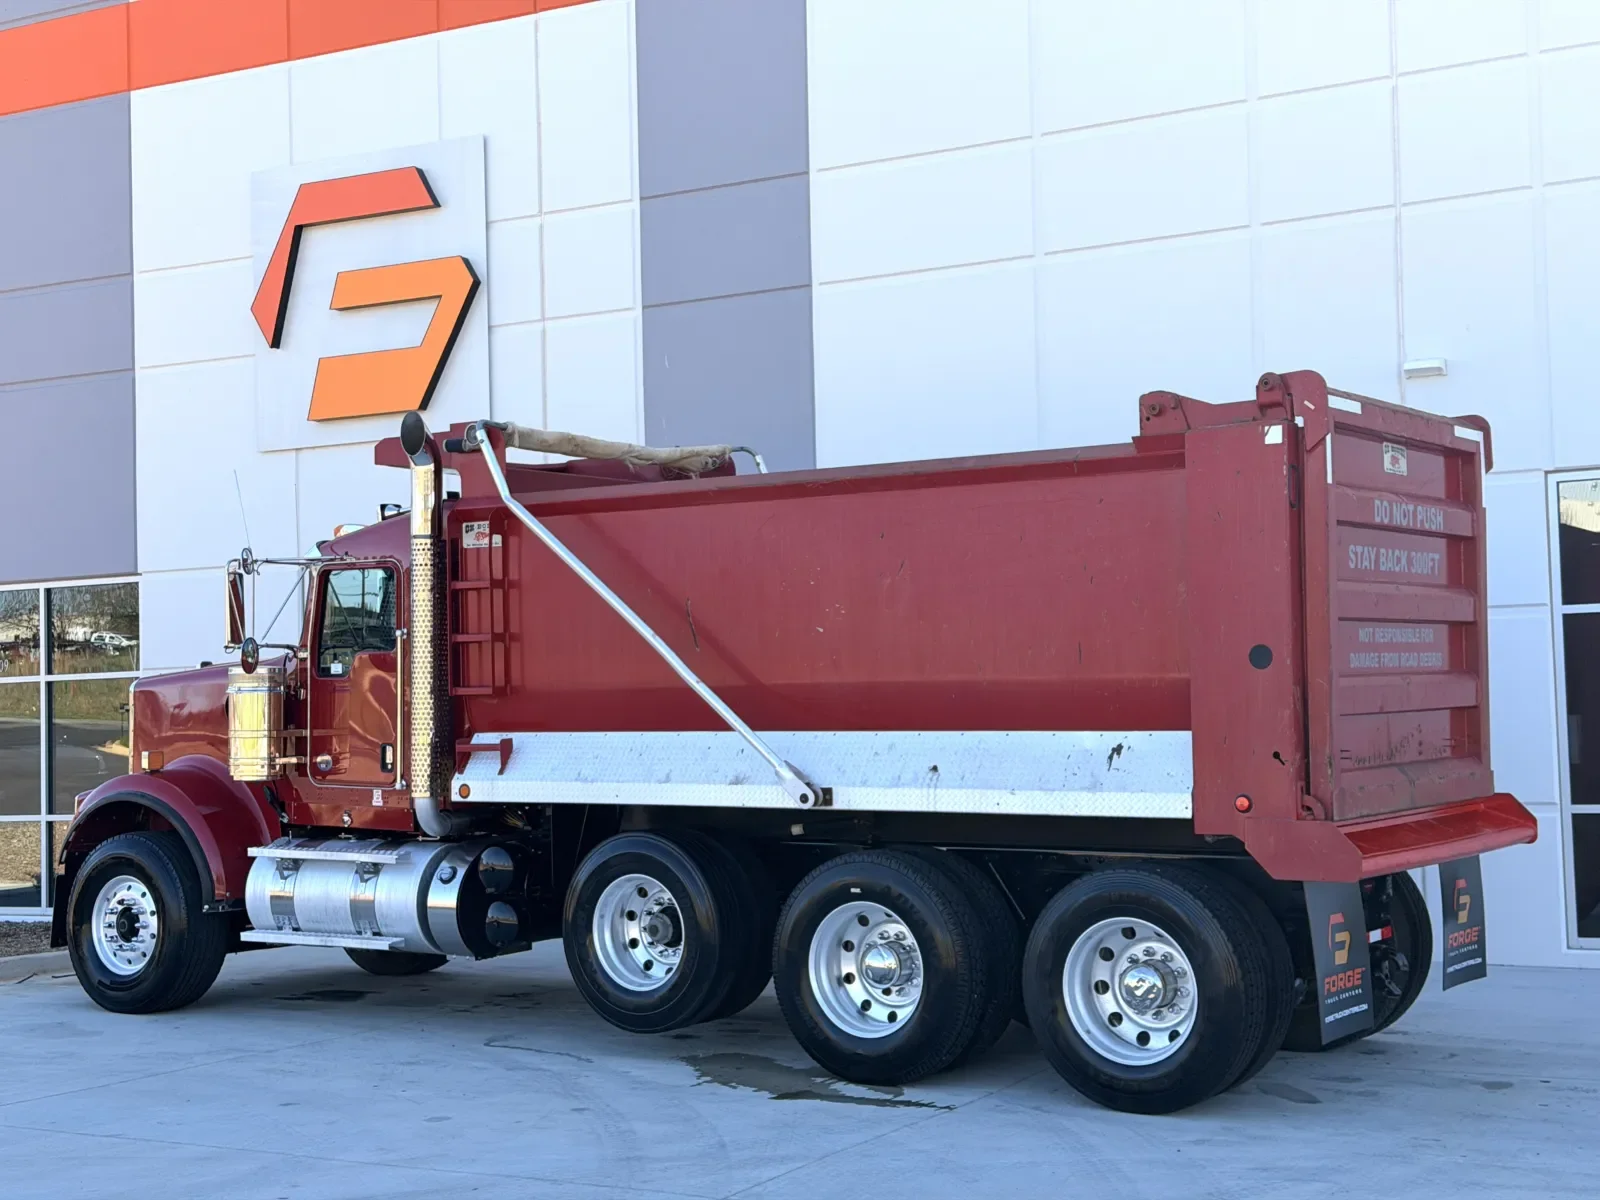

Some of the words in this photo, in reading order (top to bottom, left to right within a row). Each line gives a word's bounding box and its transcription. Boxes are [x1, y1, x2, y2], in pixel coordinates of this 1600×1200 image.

[1374, 499, 1390, 524] DO
[1392, 502, 1414, 527] NOT
[1416, 505, 1444, 531] PUSH
[1348, 544, 1377, 571] STAY
[1379, 547, 1408, 573] BACK
[1410, 551, 1440, 576] 300FT
[1358, 627, 1374, 643] NOT
[1374, 627, 1420, 643] RESPONSIBLE
[1420, 627, 1434, 643] FOR
[1349, 652, 1379, 669] DAMAGE
[1380, 652, 1400, 669] FROM
[1400, 652, 1419, 668] ROAD
[1419, 652, 1443, 668] DEBRIS
[1447, 926, 1481, 950] FORGE
[1324, 967, 1363, 996] FORGE
